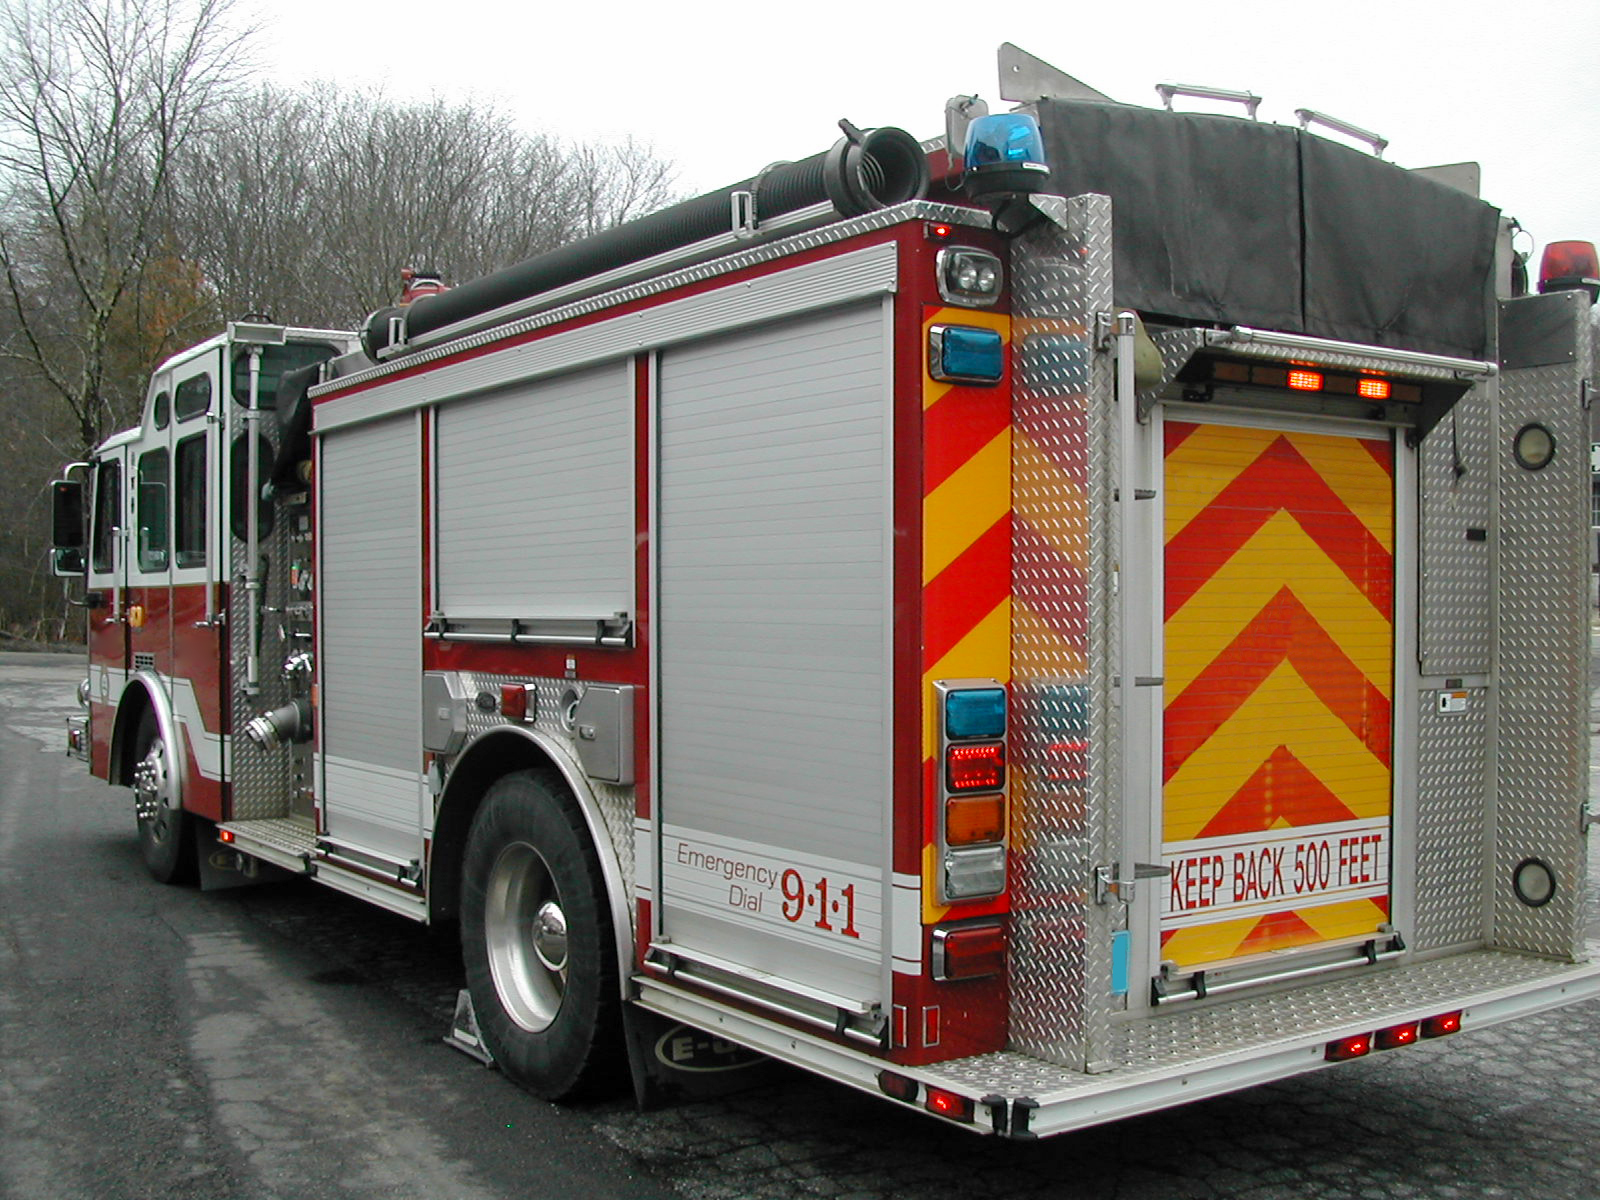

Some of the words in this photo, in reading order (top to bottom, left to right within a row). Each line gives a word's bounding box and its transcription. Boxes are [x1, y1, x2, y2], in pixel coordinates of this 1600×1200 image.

[677, 843, 778, 889] Emergency
[1170, 856, 1224, 911] KEEP
[1234, 846, 1285, 902] BACK
[1295, 840, 1330, 894] 500
[1339, 835, 1382, 886] FEET
[729, 885, 763, 912] Dial
